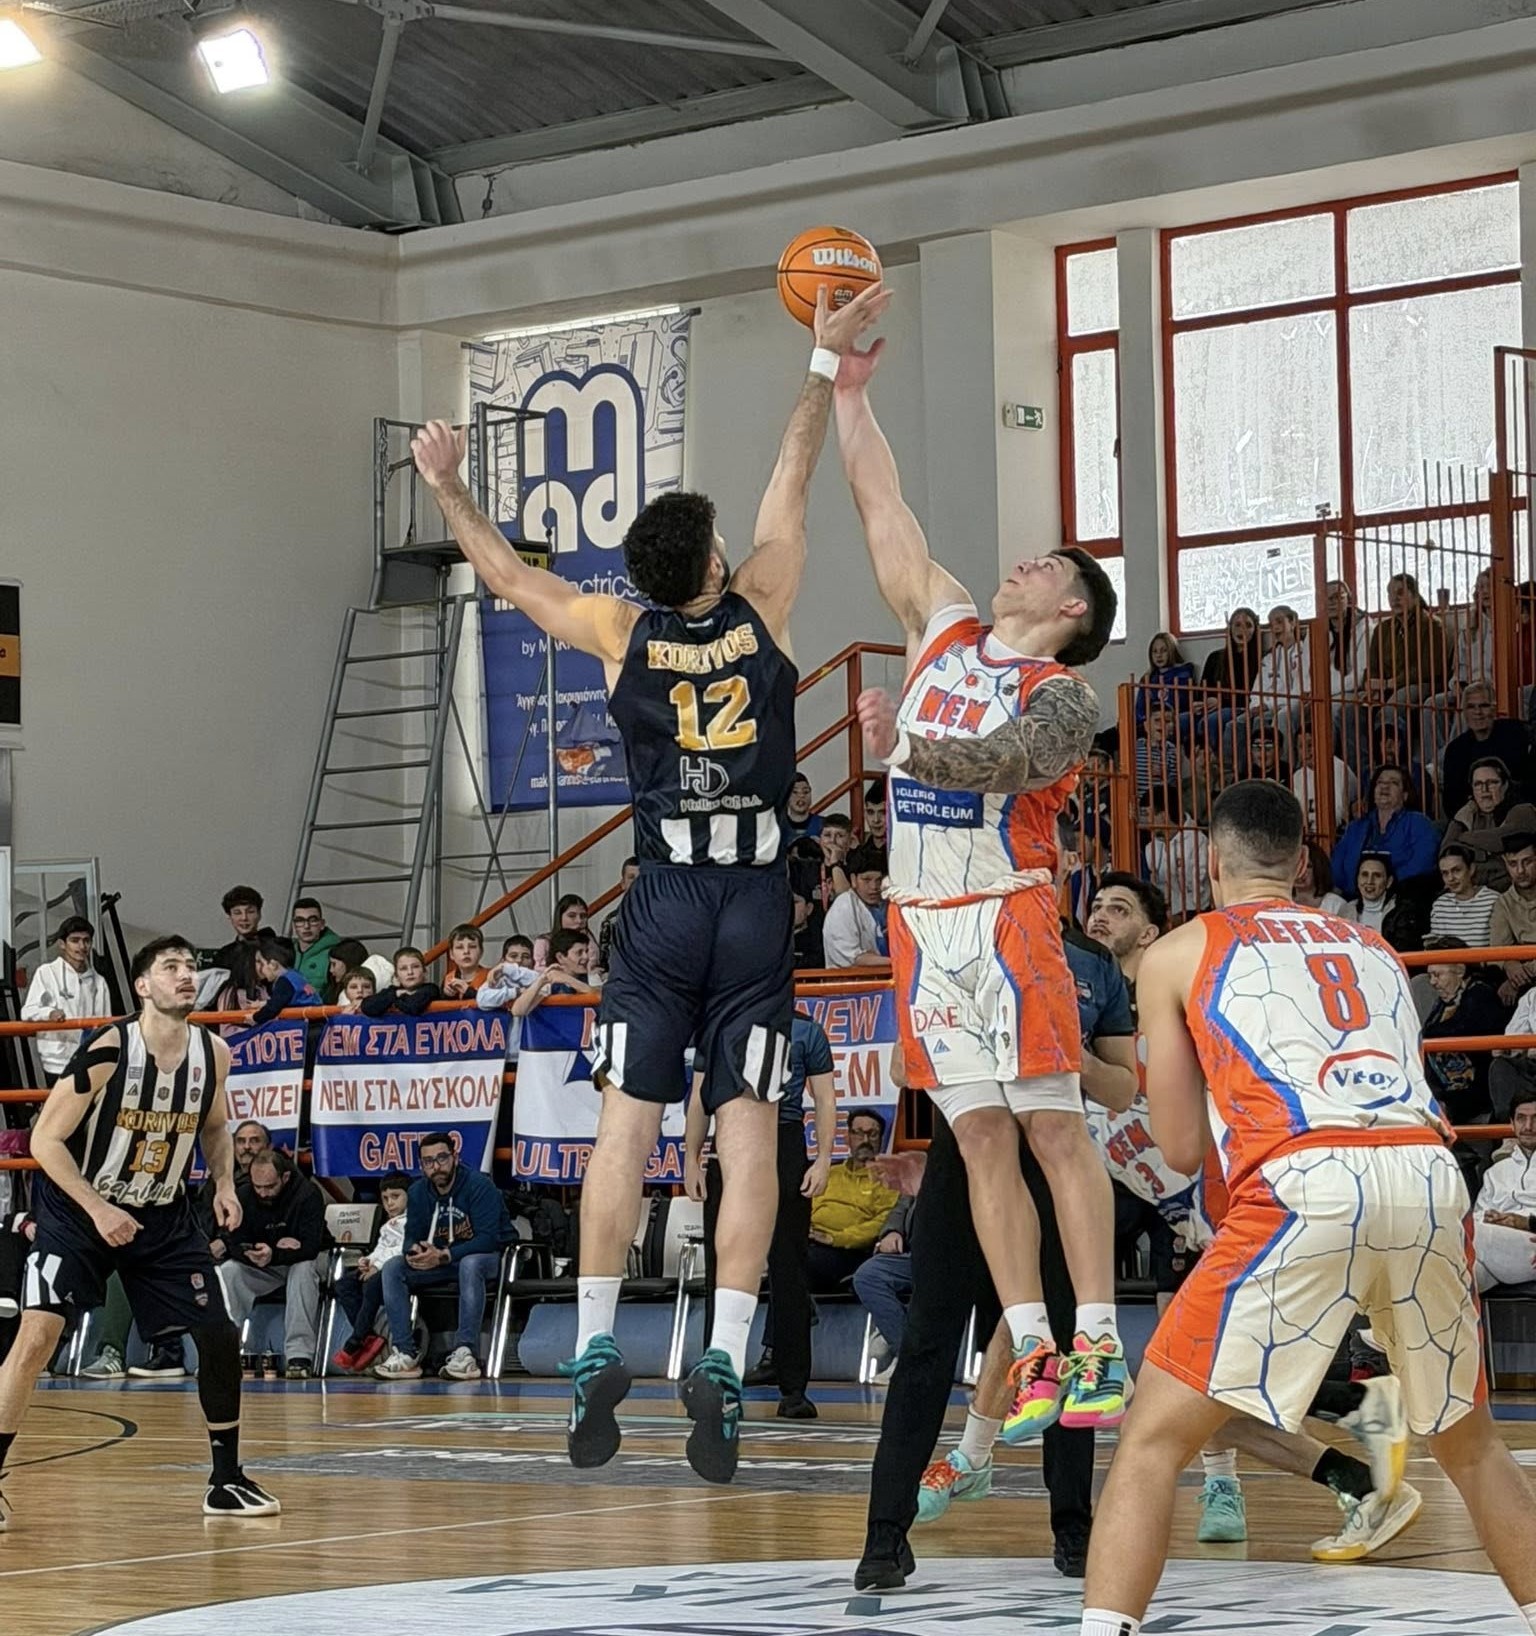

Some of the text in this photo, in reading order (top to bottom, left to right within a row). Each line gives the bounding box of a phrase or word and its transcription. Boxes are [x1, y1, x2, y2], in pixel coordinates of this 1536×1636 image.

[813, 248, 877, 275] Wilson
[521, 640, 536, 658] by
[669, 674, 757, 752] 12
[897, 800, 974, 820] PETROLEUM
[1305, 953, 1371, 1032] 8
[365, 1023, 410, 1056] ΣΤΑ
[415, 1017, 506, 1055] ΕΥΚΟΛΑ
[319, 1074, 500, 1112] ΝΕΜ ΣΤΑ ΔΥΣΚΟΛΑ
[116, 1107, 200, 1133] KORIVOS
[129, 1140, 171, 1173] 13
[359, 1131, 422, 1172] GAT
[1135, 1161, 1165, 1195] 3
